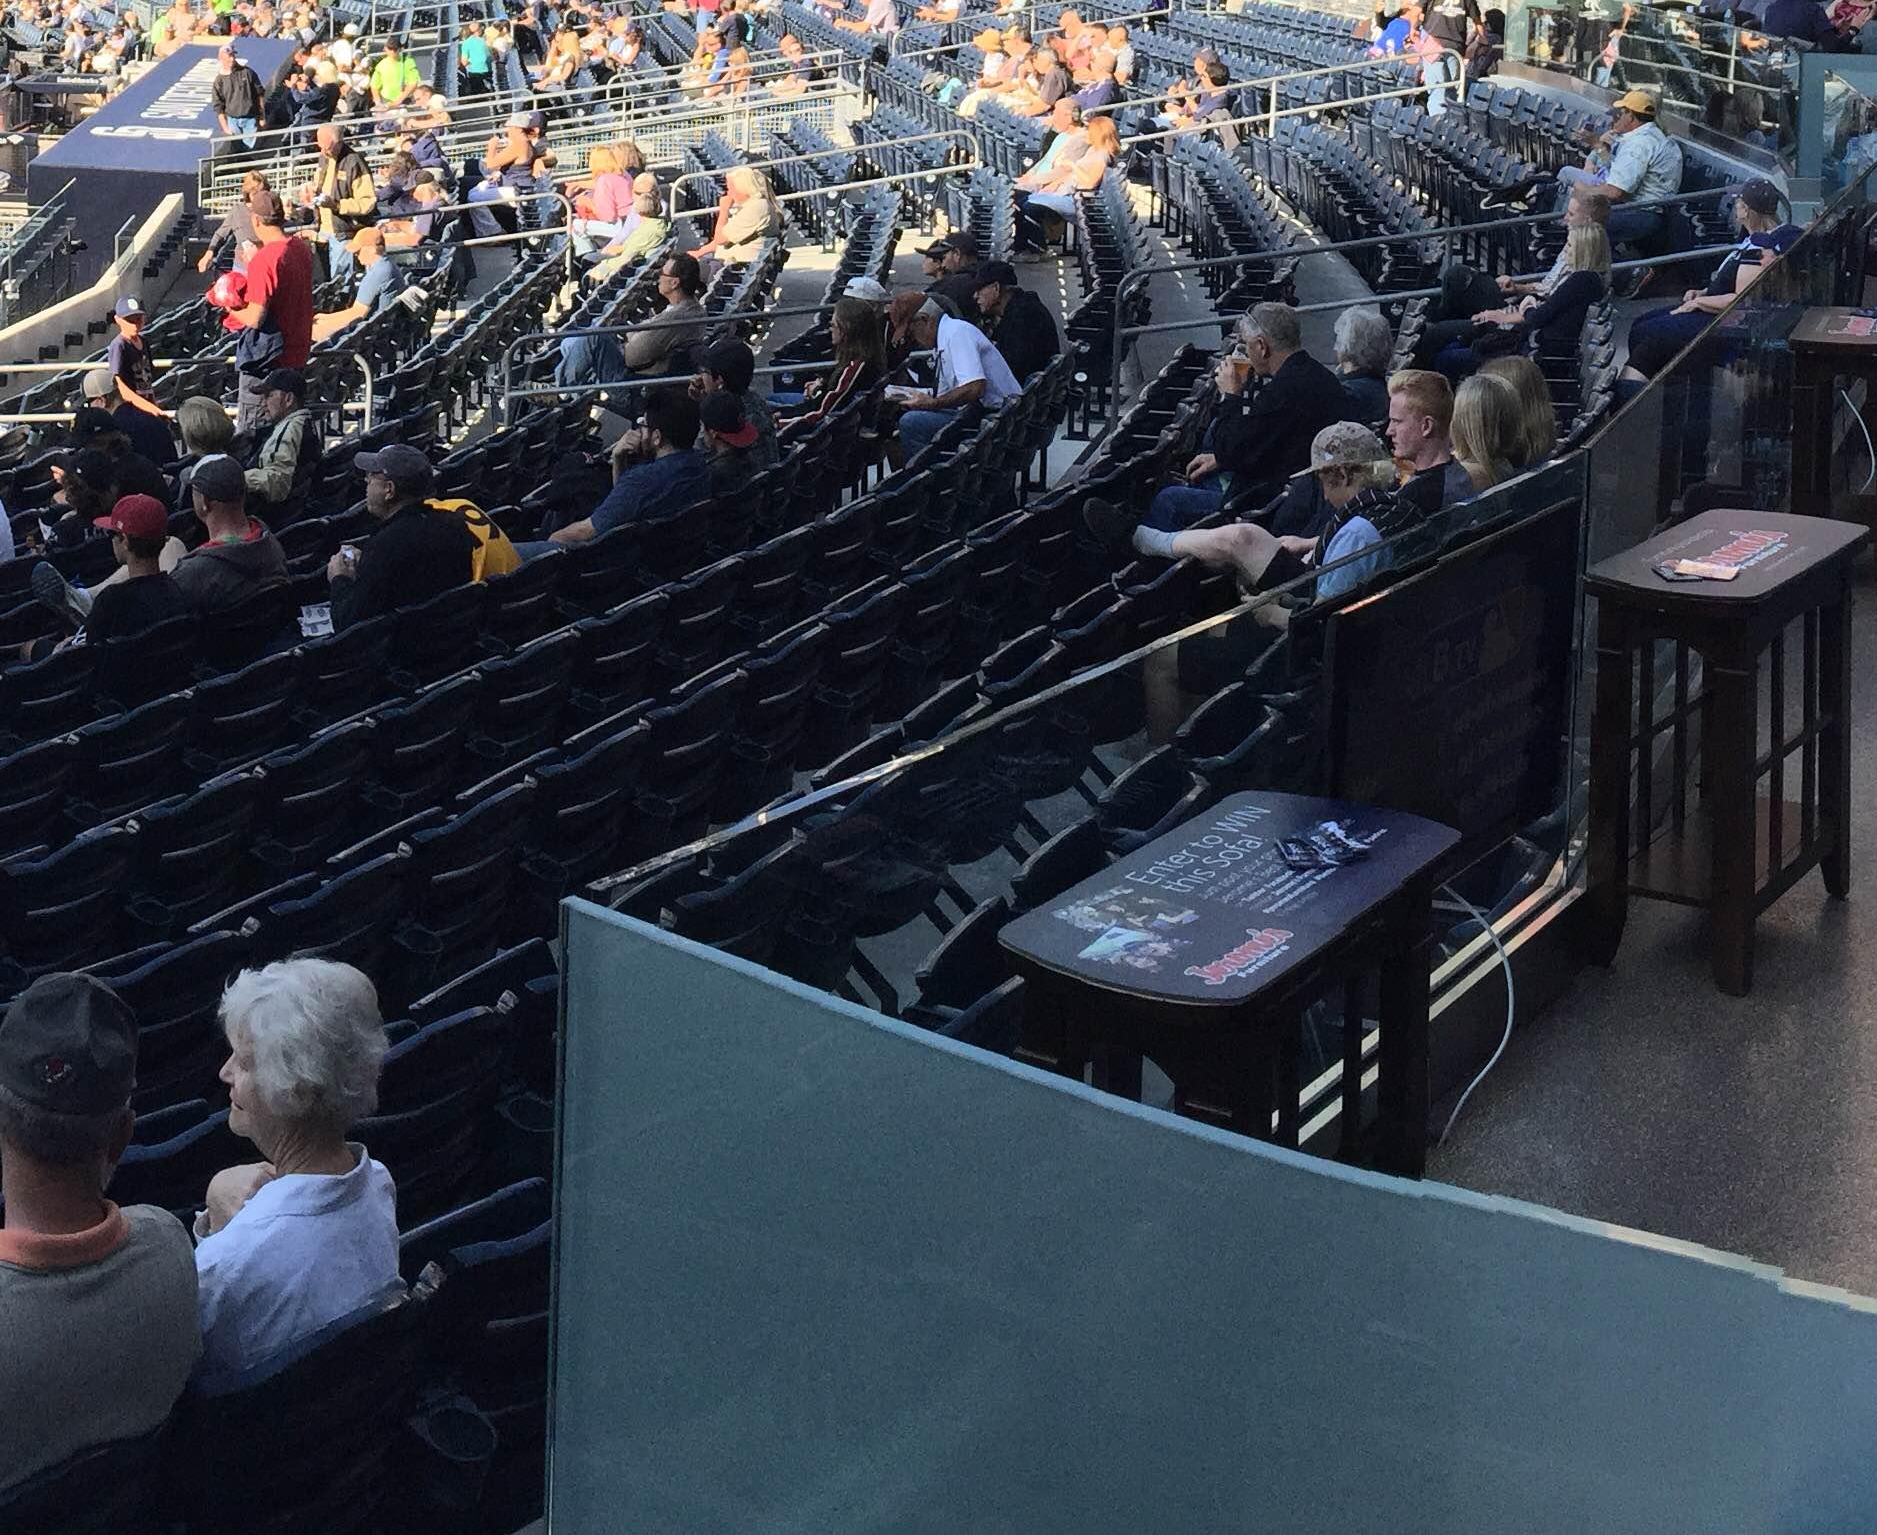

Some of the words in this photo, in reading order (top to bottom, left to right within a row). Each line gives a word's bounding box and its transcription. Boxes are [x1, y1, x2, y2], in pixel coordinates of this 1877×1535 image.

[1125, 849, 1201, 887] Enter
[1192, 833, 1223, 854] to
[1215, 804, 1272, 833] WIN
[1162, 869, 1213, 894] this
[1212, 833, 1268, 870] Sofa!
